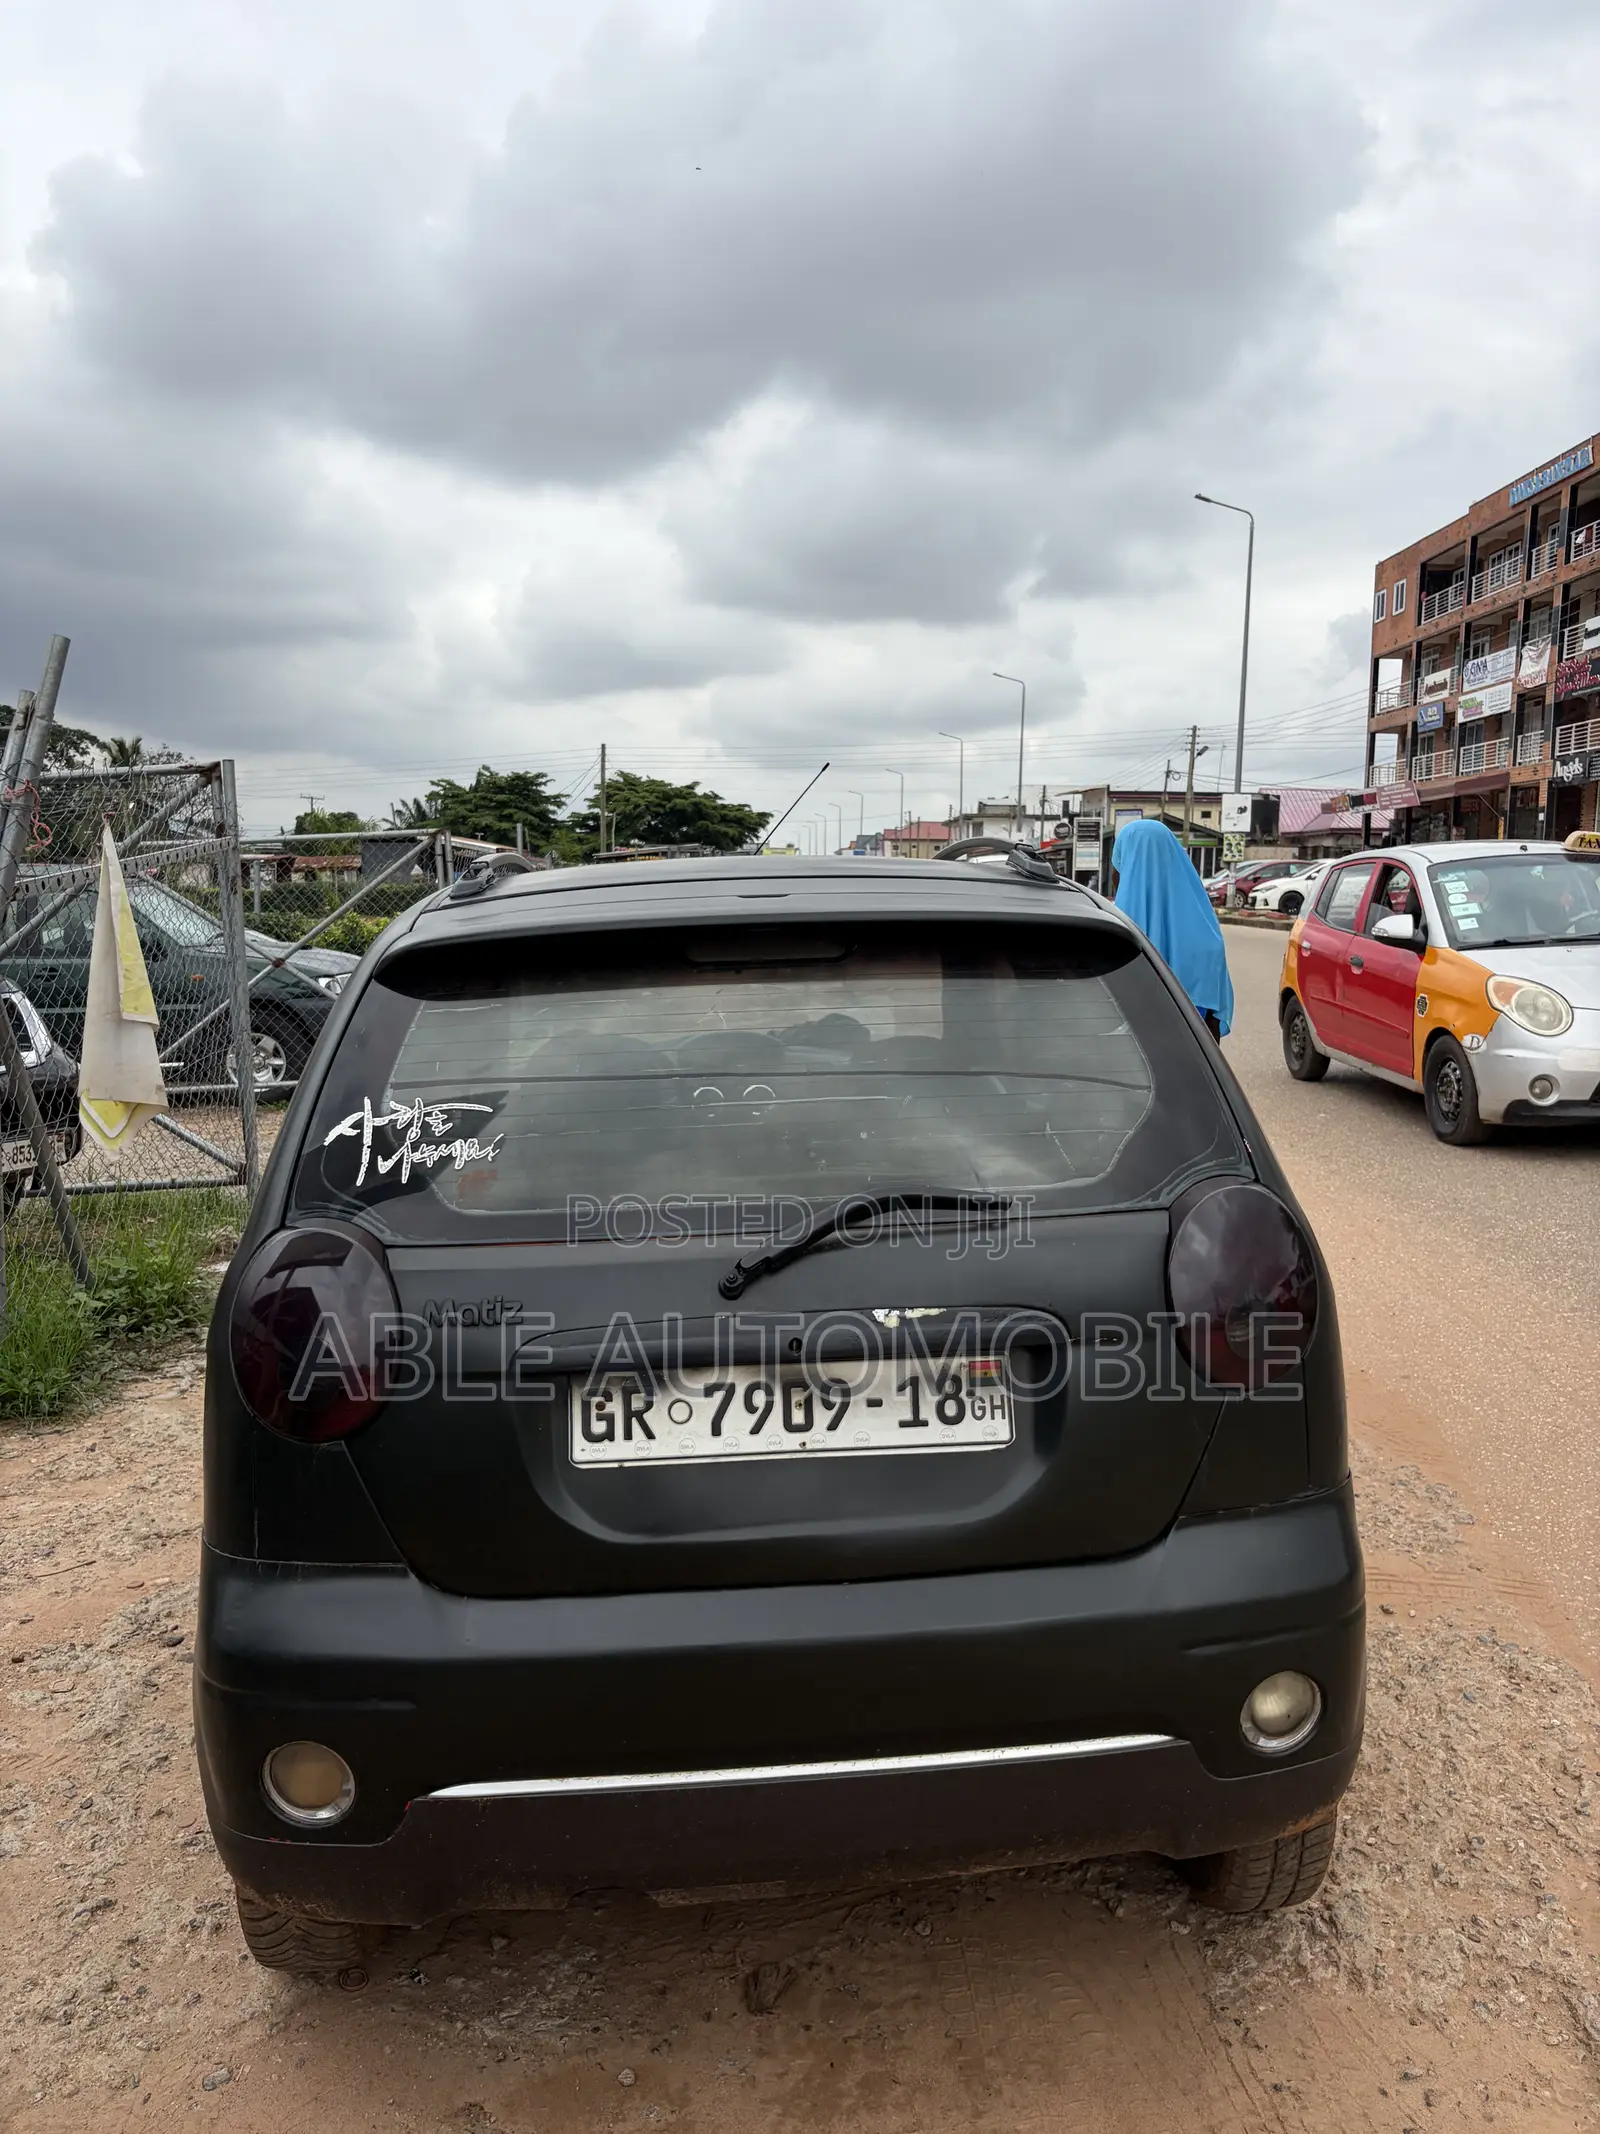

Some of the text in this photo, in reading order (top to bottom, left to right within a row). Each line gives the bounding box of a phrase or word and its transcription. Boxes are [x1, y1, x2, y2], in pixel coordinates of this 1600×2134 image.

[1553, 757, 1583, 783] Angels
[422, 1295, 524, 1329] Matiz
[581, 1386, 656, 1443] GR
[970, 1394, 1006, 1421] GH
